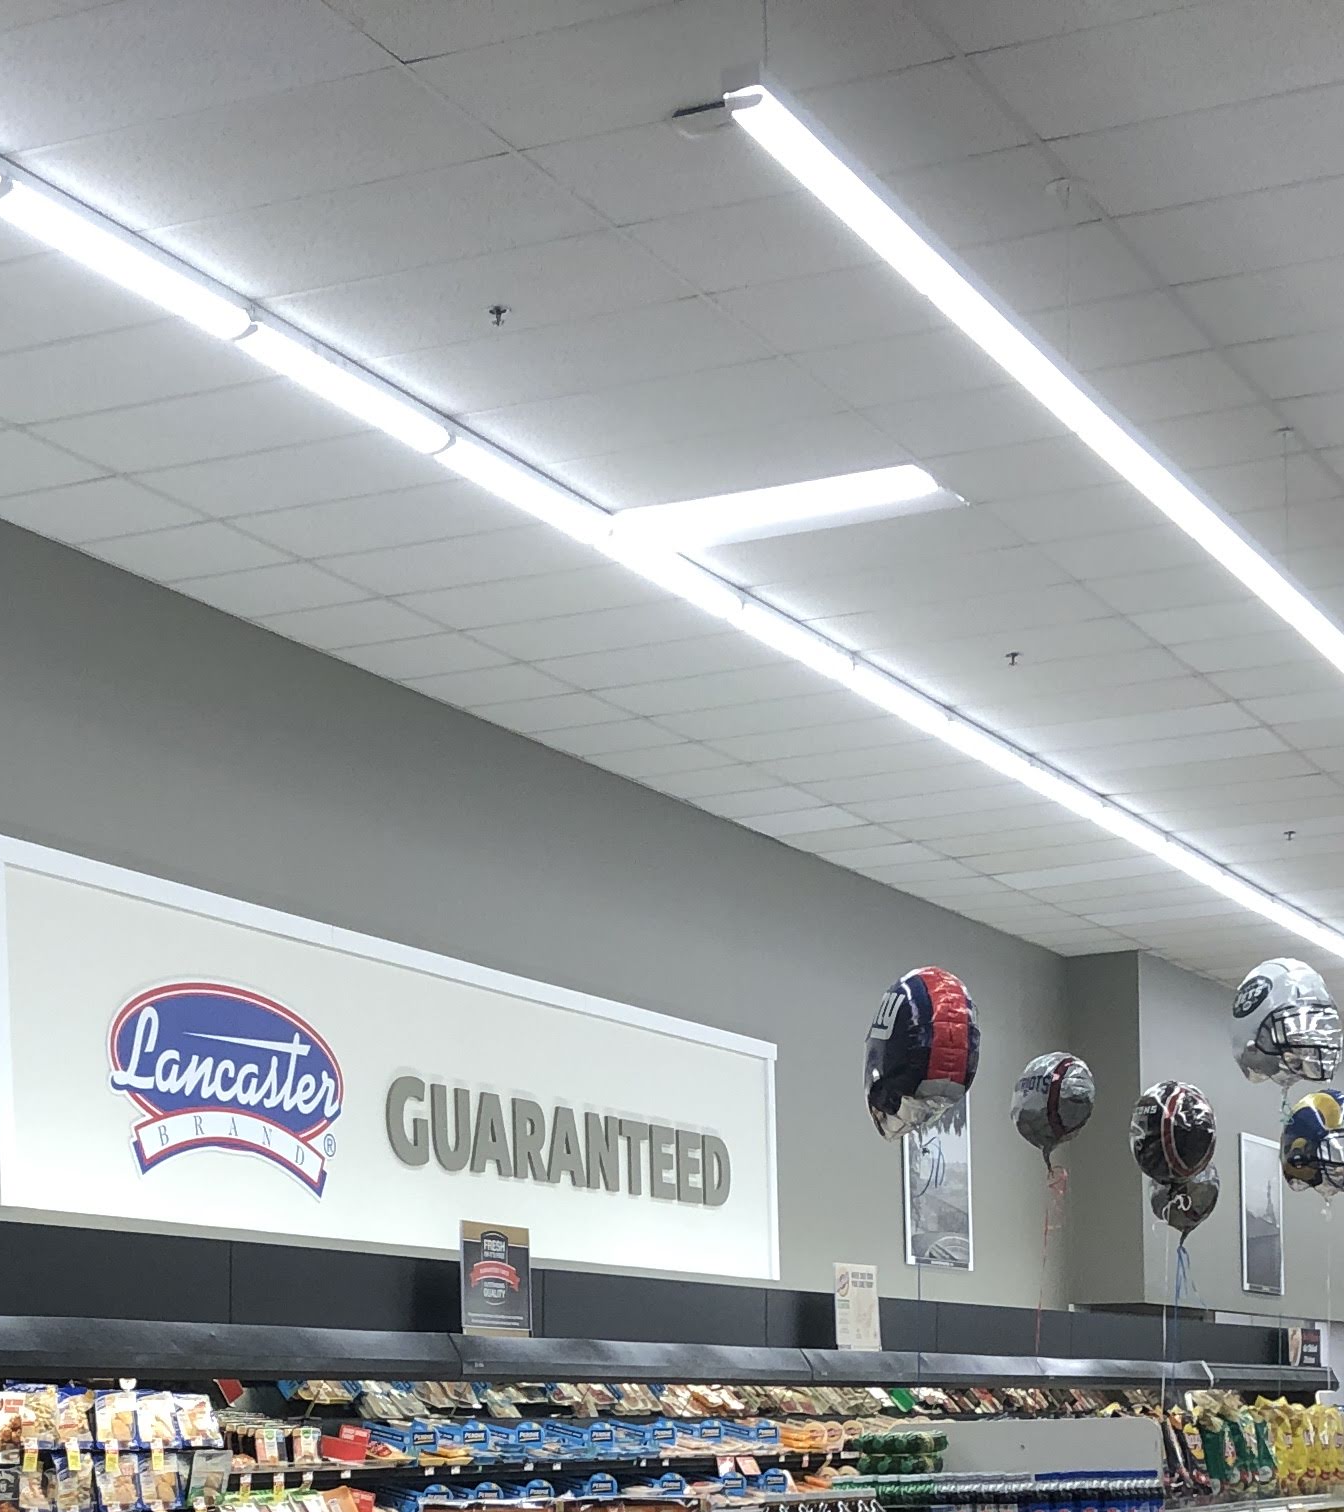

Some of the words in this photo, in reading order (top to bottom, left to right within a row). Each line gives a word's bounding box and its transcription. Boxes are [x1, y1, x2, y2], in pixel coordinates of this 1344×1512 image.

[109, 1006, 343, 1120] Lancaster
[156, 1115, 308, 1167] BRAND
[384, 1073, 733, 1207] GUARANTEED
